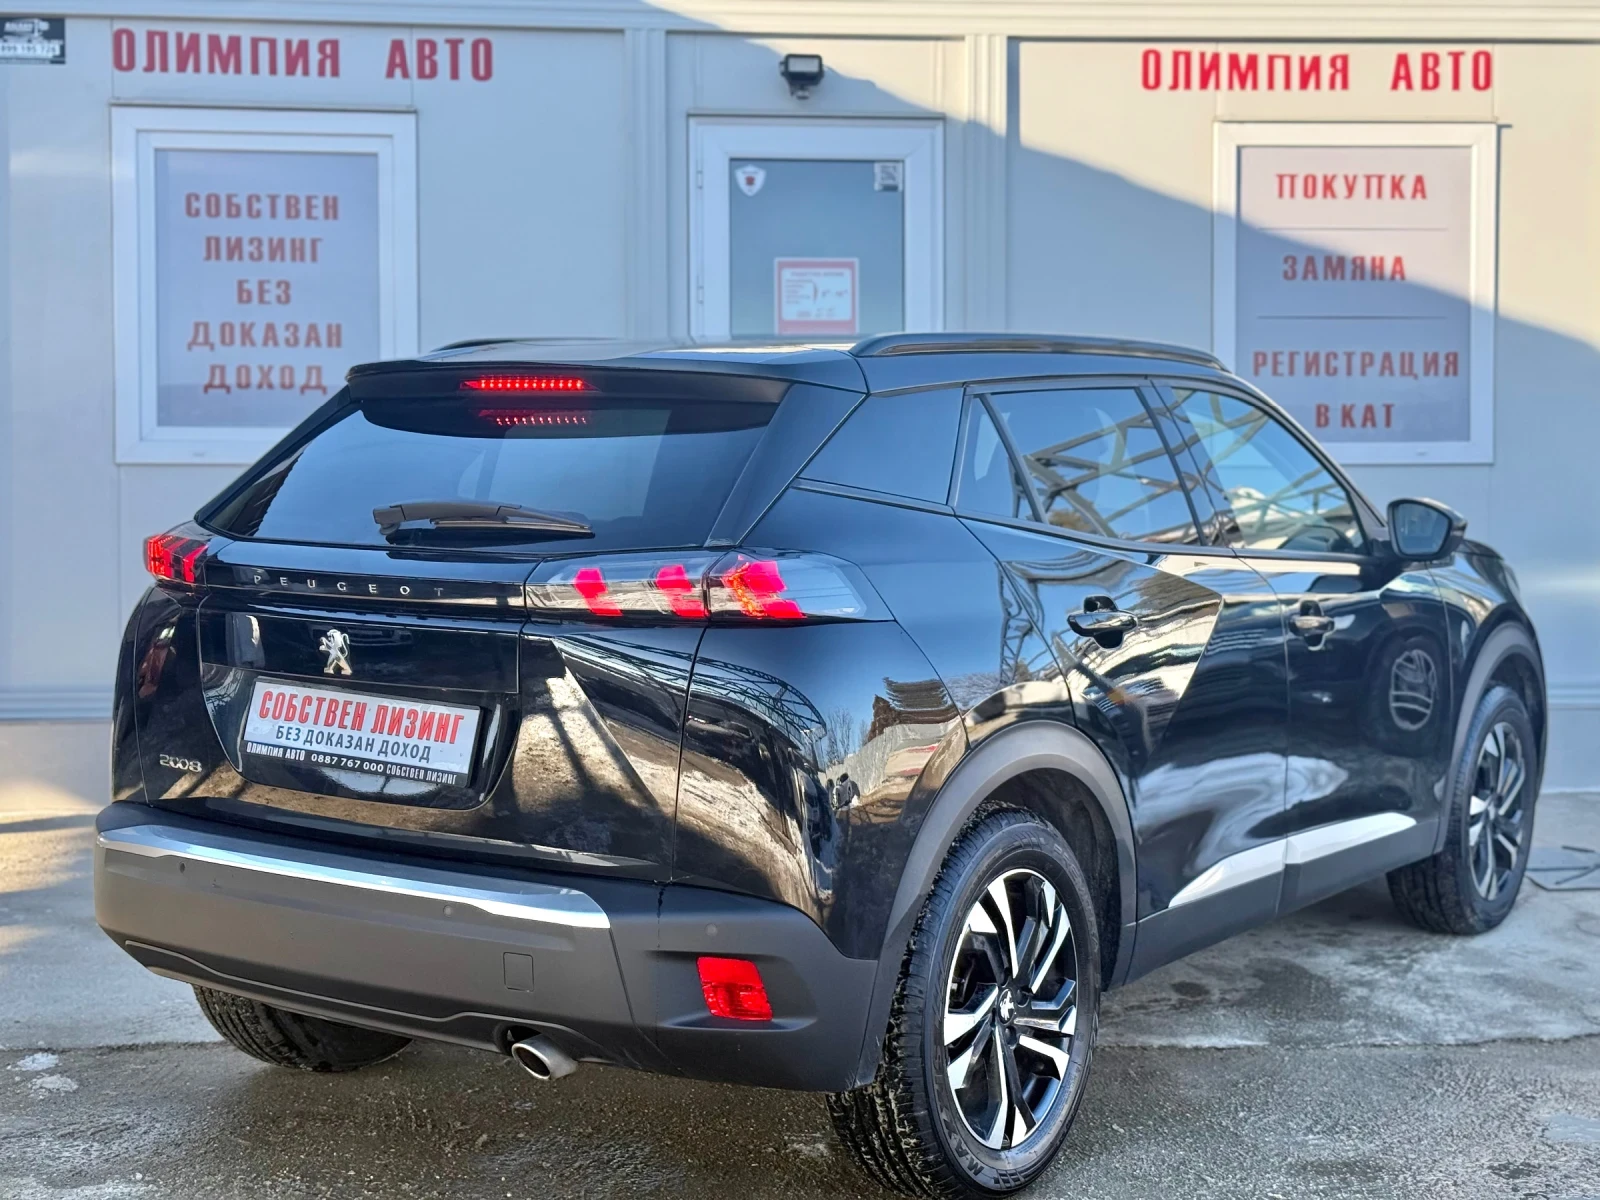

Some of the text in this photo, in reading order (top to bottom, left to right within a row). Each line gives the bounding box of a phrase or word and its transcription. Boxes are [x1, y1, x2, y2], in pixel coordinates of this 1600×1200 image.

[113, 28, 493, 82] ОЛИМПИЯ АВТО
[1141, 48, 1493, 92] ОЛИМПИЯ АВТО
[1276, 173, 1428, 200] ПОКУПКА
[185, 192, 339, 221] СОБСТВЕН
[203, 236, 323, 263] ЛИЗИНГ
[1283, 255, 1406, 281] ЗАМЯНА
[236, 279, 291, 305] БЕЗ
[187, 321, 342, 352] ДОКАЗАН
[1252, 350, 1459, 380] РЕГИСТРАЦИЯ
[203, 364, 328, 396] ДОХОД
[1315, 403, 1395, 429] В КАТ
[253, 574, 444, 597] PEUGEOT
[259, 690, 464, 744] СОБСТВЕН ЛИЗИНГ
[275, 725, 431, 763] БЕЗ ДОКАЗАН ДОХОД
[160, 754, 202, 772] 2008
[246, 741, 458, 786] ОЛИМПИЯ АВТО 0887 767 000 СОБСТВЕН ЛИЗИНГ
